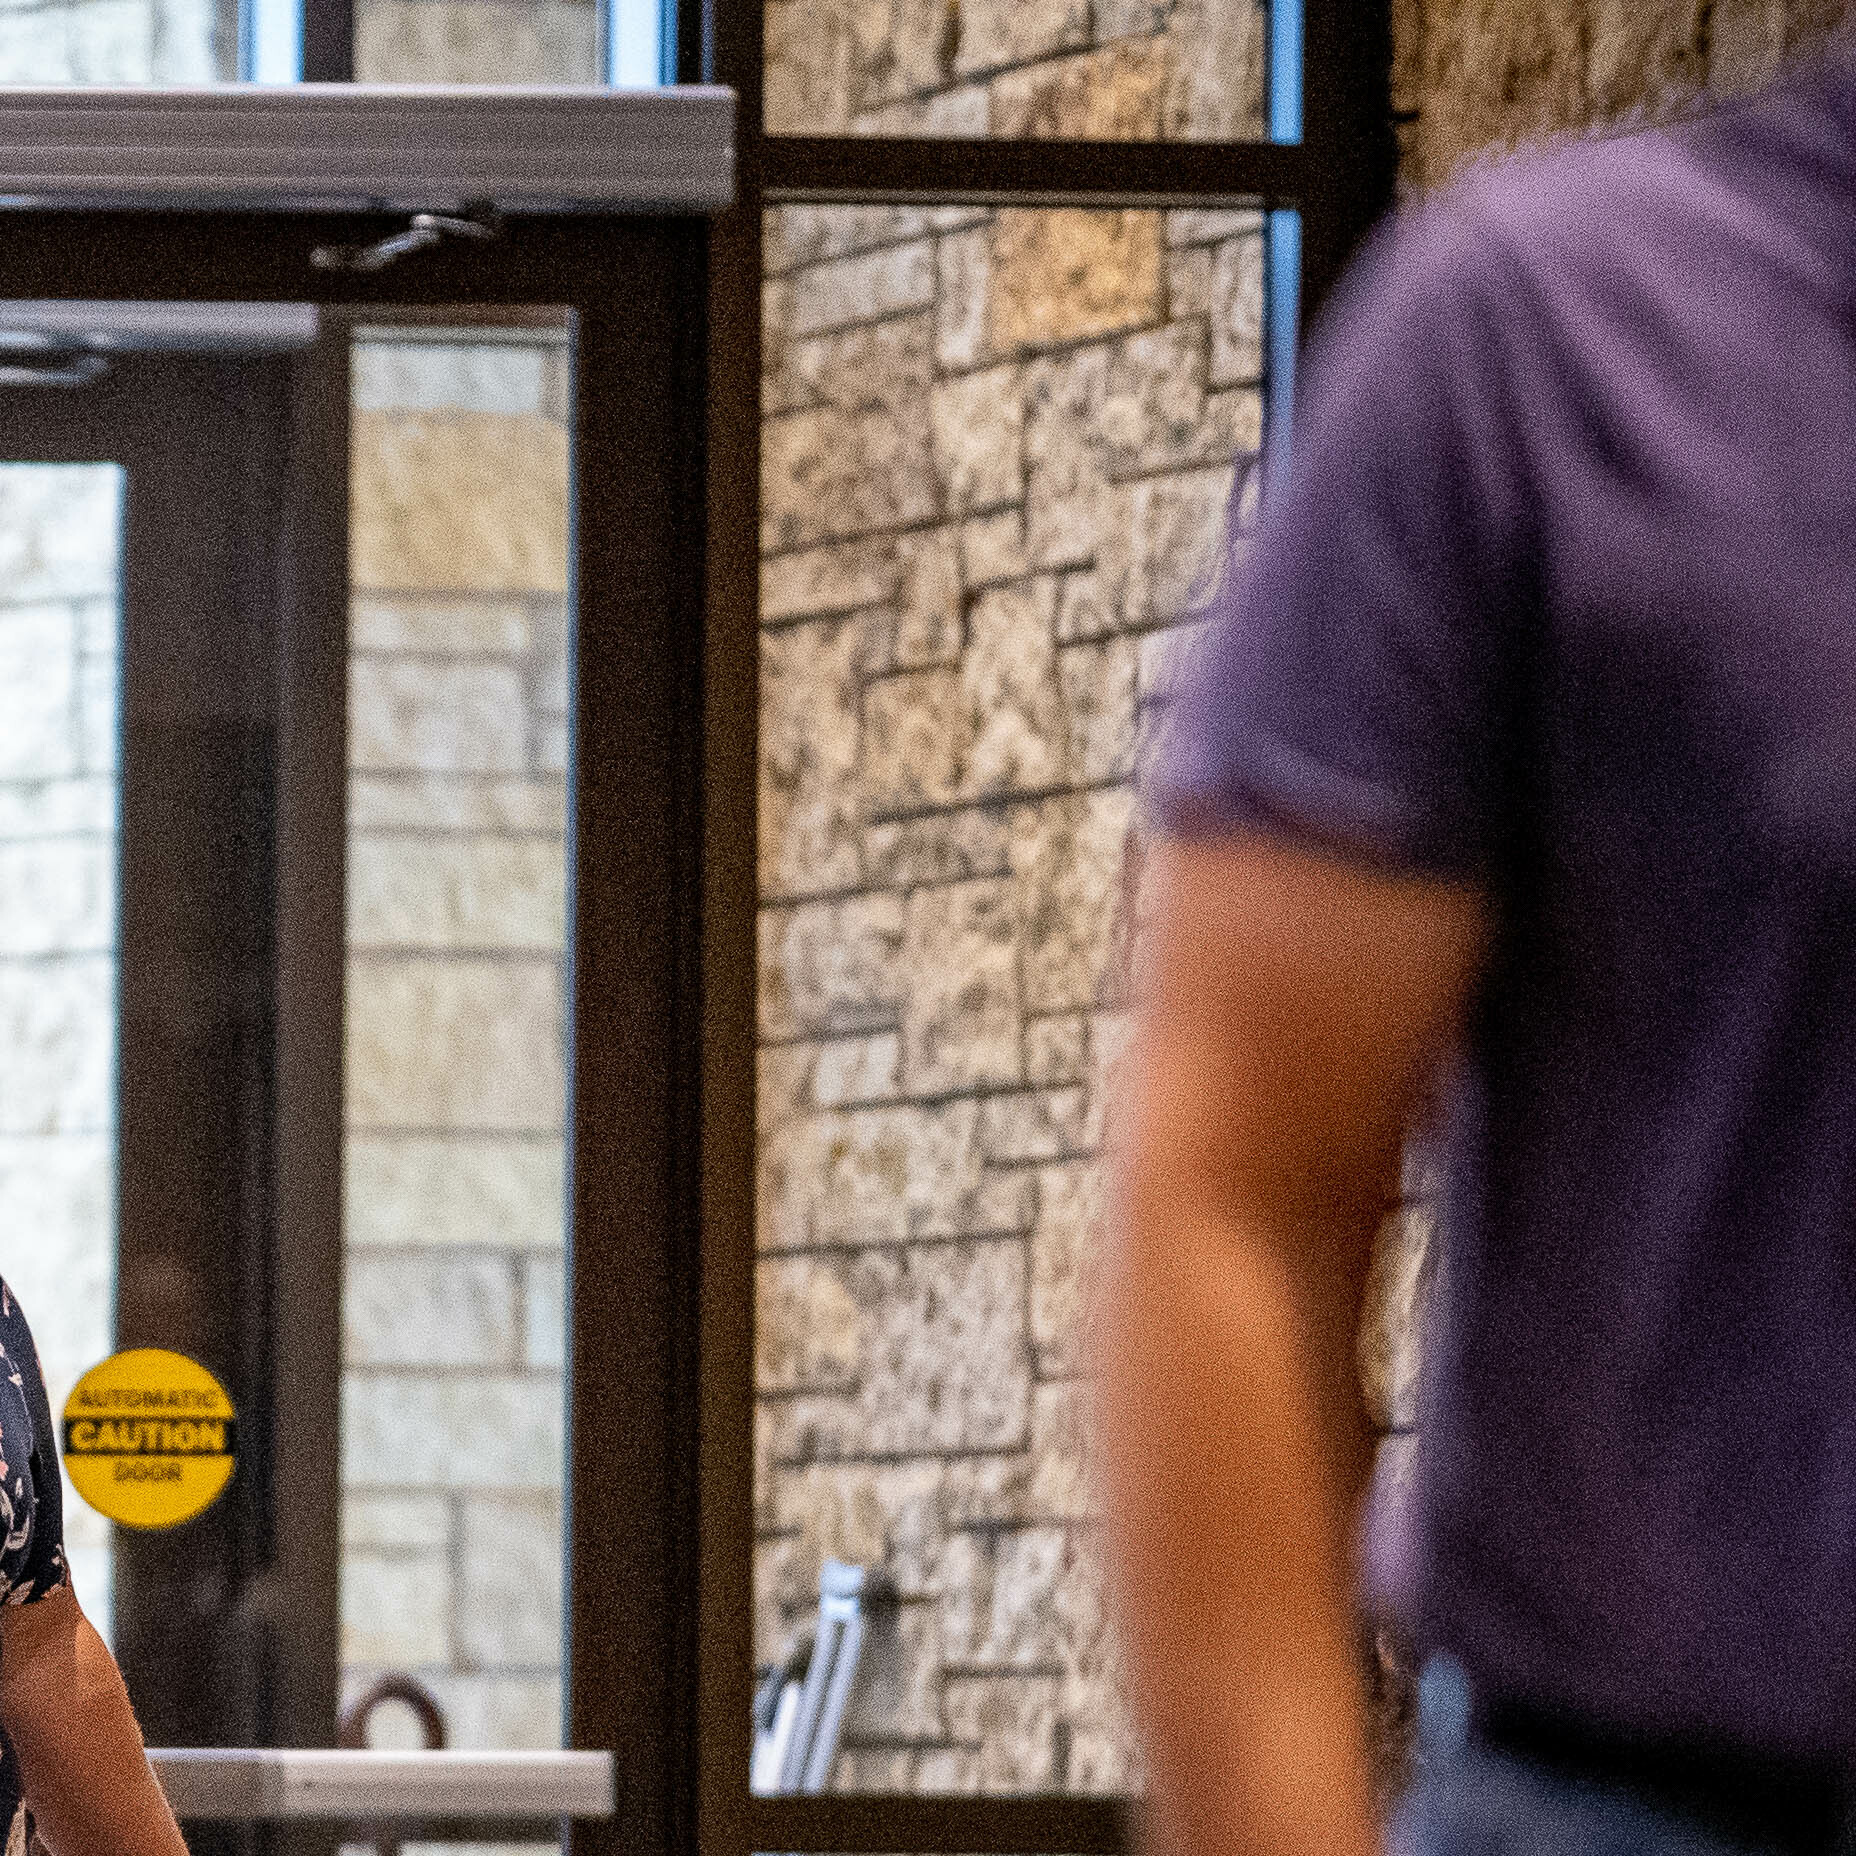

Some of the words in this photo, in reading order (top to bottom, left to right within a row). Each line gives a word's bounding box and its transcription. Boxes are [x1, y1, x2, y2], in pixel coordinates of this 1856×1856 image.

[79, 1389, 218, 1408] AUTOMATIC
[70, 1420, 226, 1451] CAUTION
[114, 1462, 182, 1482] DOOR
